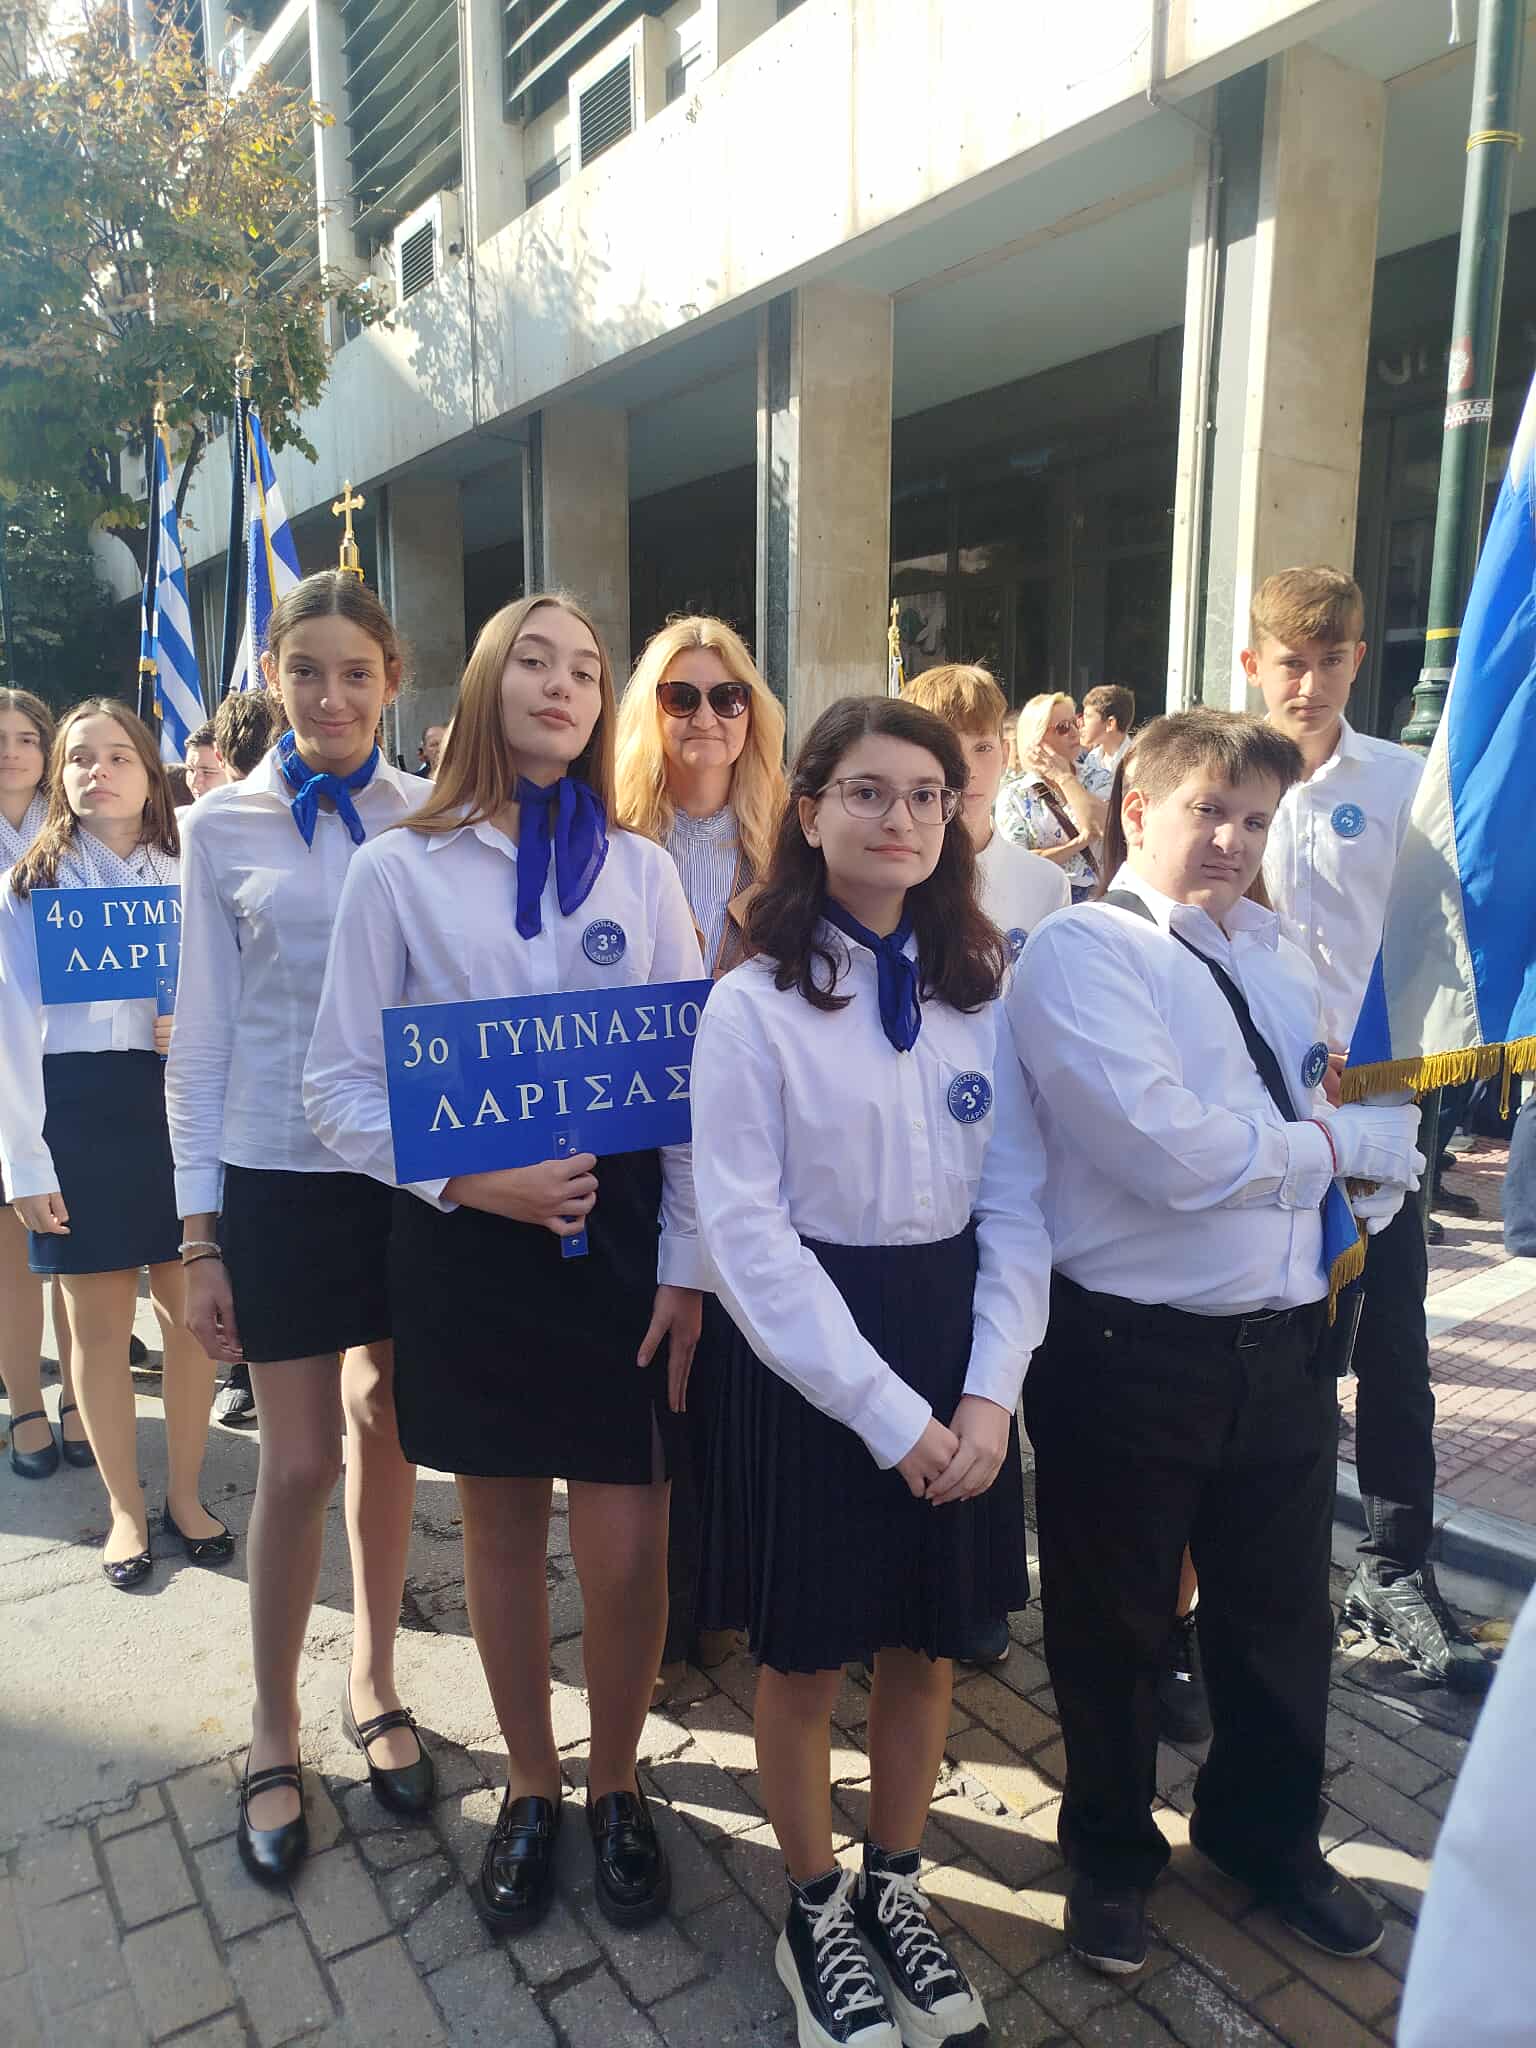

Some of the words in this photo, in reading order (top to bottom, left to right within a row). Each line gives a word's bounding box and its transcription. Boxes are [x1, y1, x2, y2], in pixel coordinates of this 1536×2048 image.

[65, 942, 183, 973] ΛΑΡΙ
[476, 1000, 702, 1059] ΓΥΜΝΑΣΙΟ
[428, 1064, 692, 1132] ΛΑΡΙΣΑΣ
